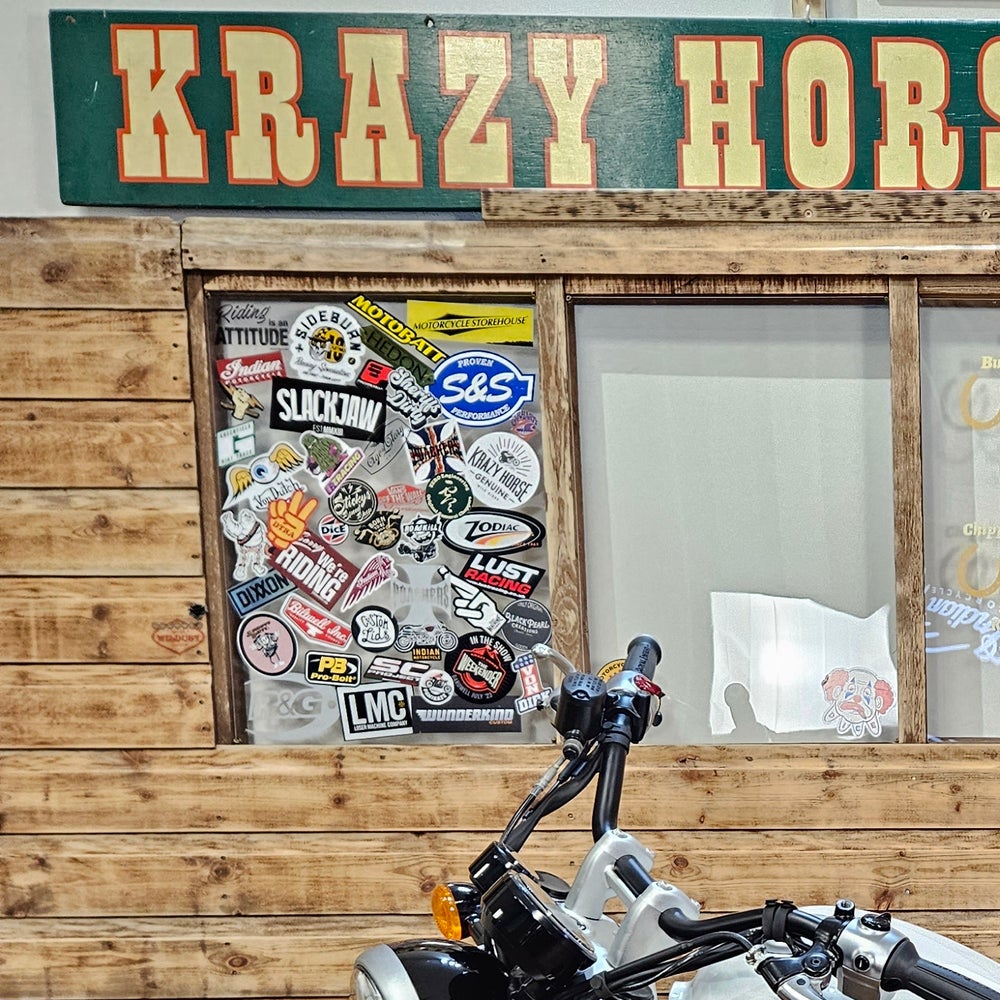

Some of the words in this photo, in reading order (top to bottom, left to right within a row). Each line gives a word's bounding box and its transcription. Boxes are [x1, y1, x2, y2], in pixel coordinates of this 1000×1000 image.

[110, 23, 607, 188] KRAZY
[217, 303, 271, 324] Riding
[413, 319, 470, 331] MOTORCYCLE
[472, 316, 528, 328] STOREHOUSE
[215, 327, 289, 346] ATTITUDE
[295, 310, 361, 351] SIDEBURN
[351, 295, 446, 363] MOTOBATT
[219, 358, 283, 380] Indian
[366, 331, 427, 381] HEDON
[457, 357, 494, 368] PROVEN
[440, 372, 515, 404] S&S
[276, 388, 383, 433] SLACKJAW
[450, 404, 511, 421] PERFORMANCE
[467, 446, 503, 477] KRAZY
[498, 470, 533, 502] HORSE
[475, 473, 510, 500] GENUINE
[464, 520, 520, 542] ZODIAC
[275, 544, 342, 602] RIDING
[317, 551, 349, 583] We're
[470, 553, 540, 583] LUST
[236, 574, 290, 608] DIXXON
[464, 568, 532, 594] RACING
[527, 618, 550, 629] PEARL
[413, 648, 440, 656] INDIAN
[469, 635, 479, 645] IN
[480, 635, 495, 646] THE
[493, 641, 513, 662] SHOW
[310, 672, 353, 683] Pro-Bolt
[318, 656, 347, 674] PB
[369, 656, 430, 677] SC
[348, 690, 407, 725] LMC
[416, 708, 514, 721] WUNDERKIND
